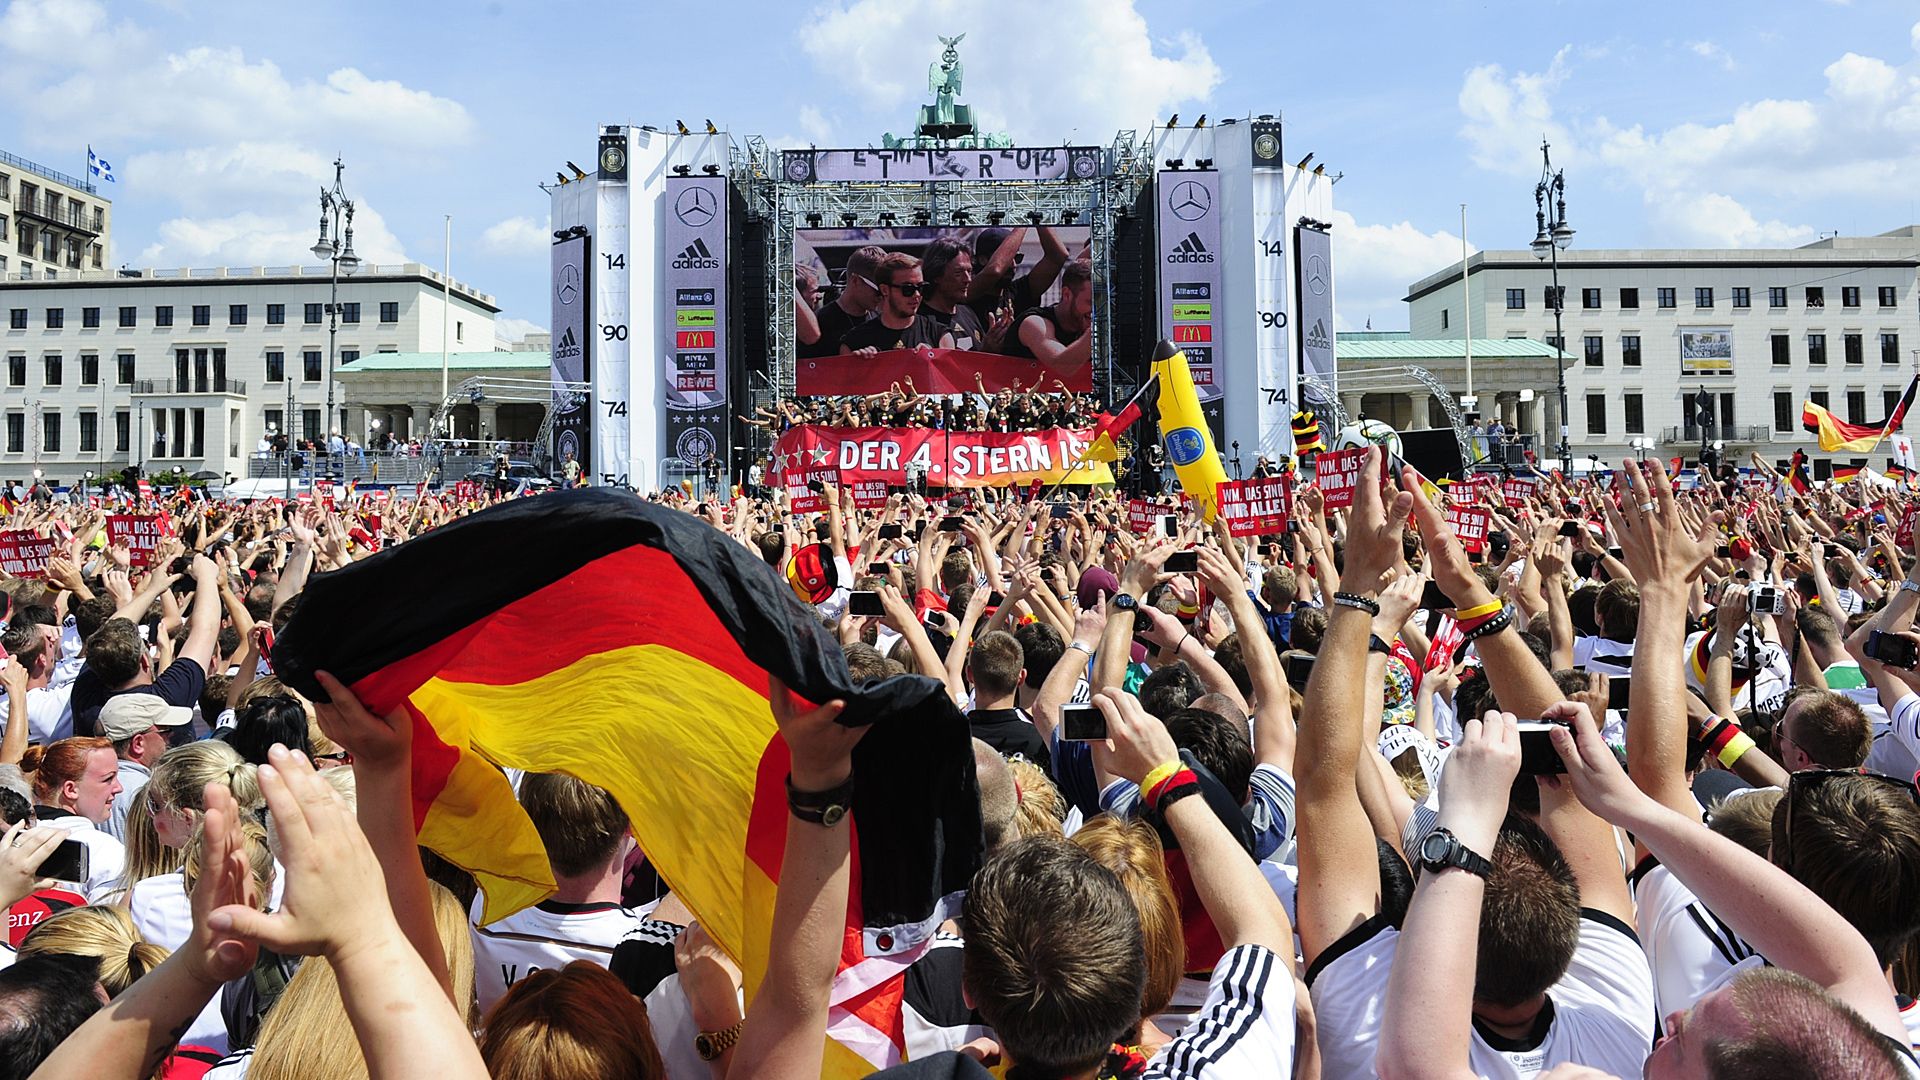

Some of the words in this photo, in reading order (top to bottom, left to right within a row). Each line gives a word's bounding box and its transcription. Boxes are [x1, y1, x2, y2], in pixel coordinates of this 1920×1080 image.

[672, 257, 719, 269] adidas
[1167, 252, 1214, 263] adidas
[678, 377, 714, 388] REWE
[838, 440, 901, 471] DER
[951, 443, 1052, 477] STERN
[1341, 456, 1358, 472] DAS
[1320, 473, 1345, 491] WIR
[788, 485, 810, 499] WIR
[1245, 485, 1262, 501] DAS
[1263, 483, 1284, 499] SIND
[1223, 503, 1249, 519] WIR
[1251, 499, 1286, 517] ALLE!
[134, 521, 149, 535] DAS
[19, 546, 35, 559] DAS
[3, 560, 26, 573] WIR
